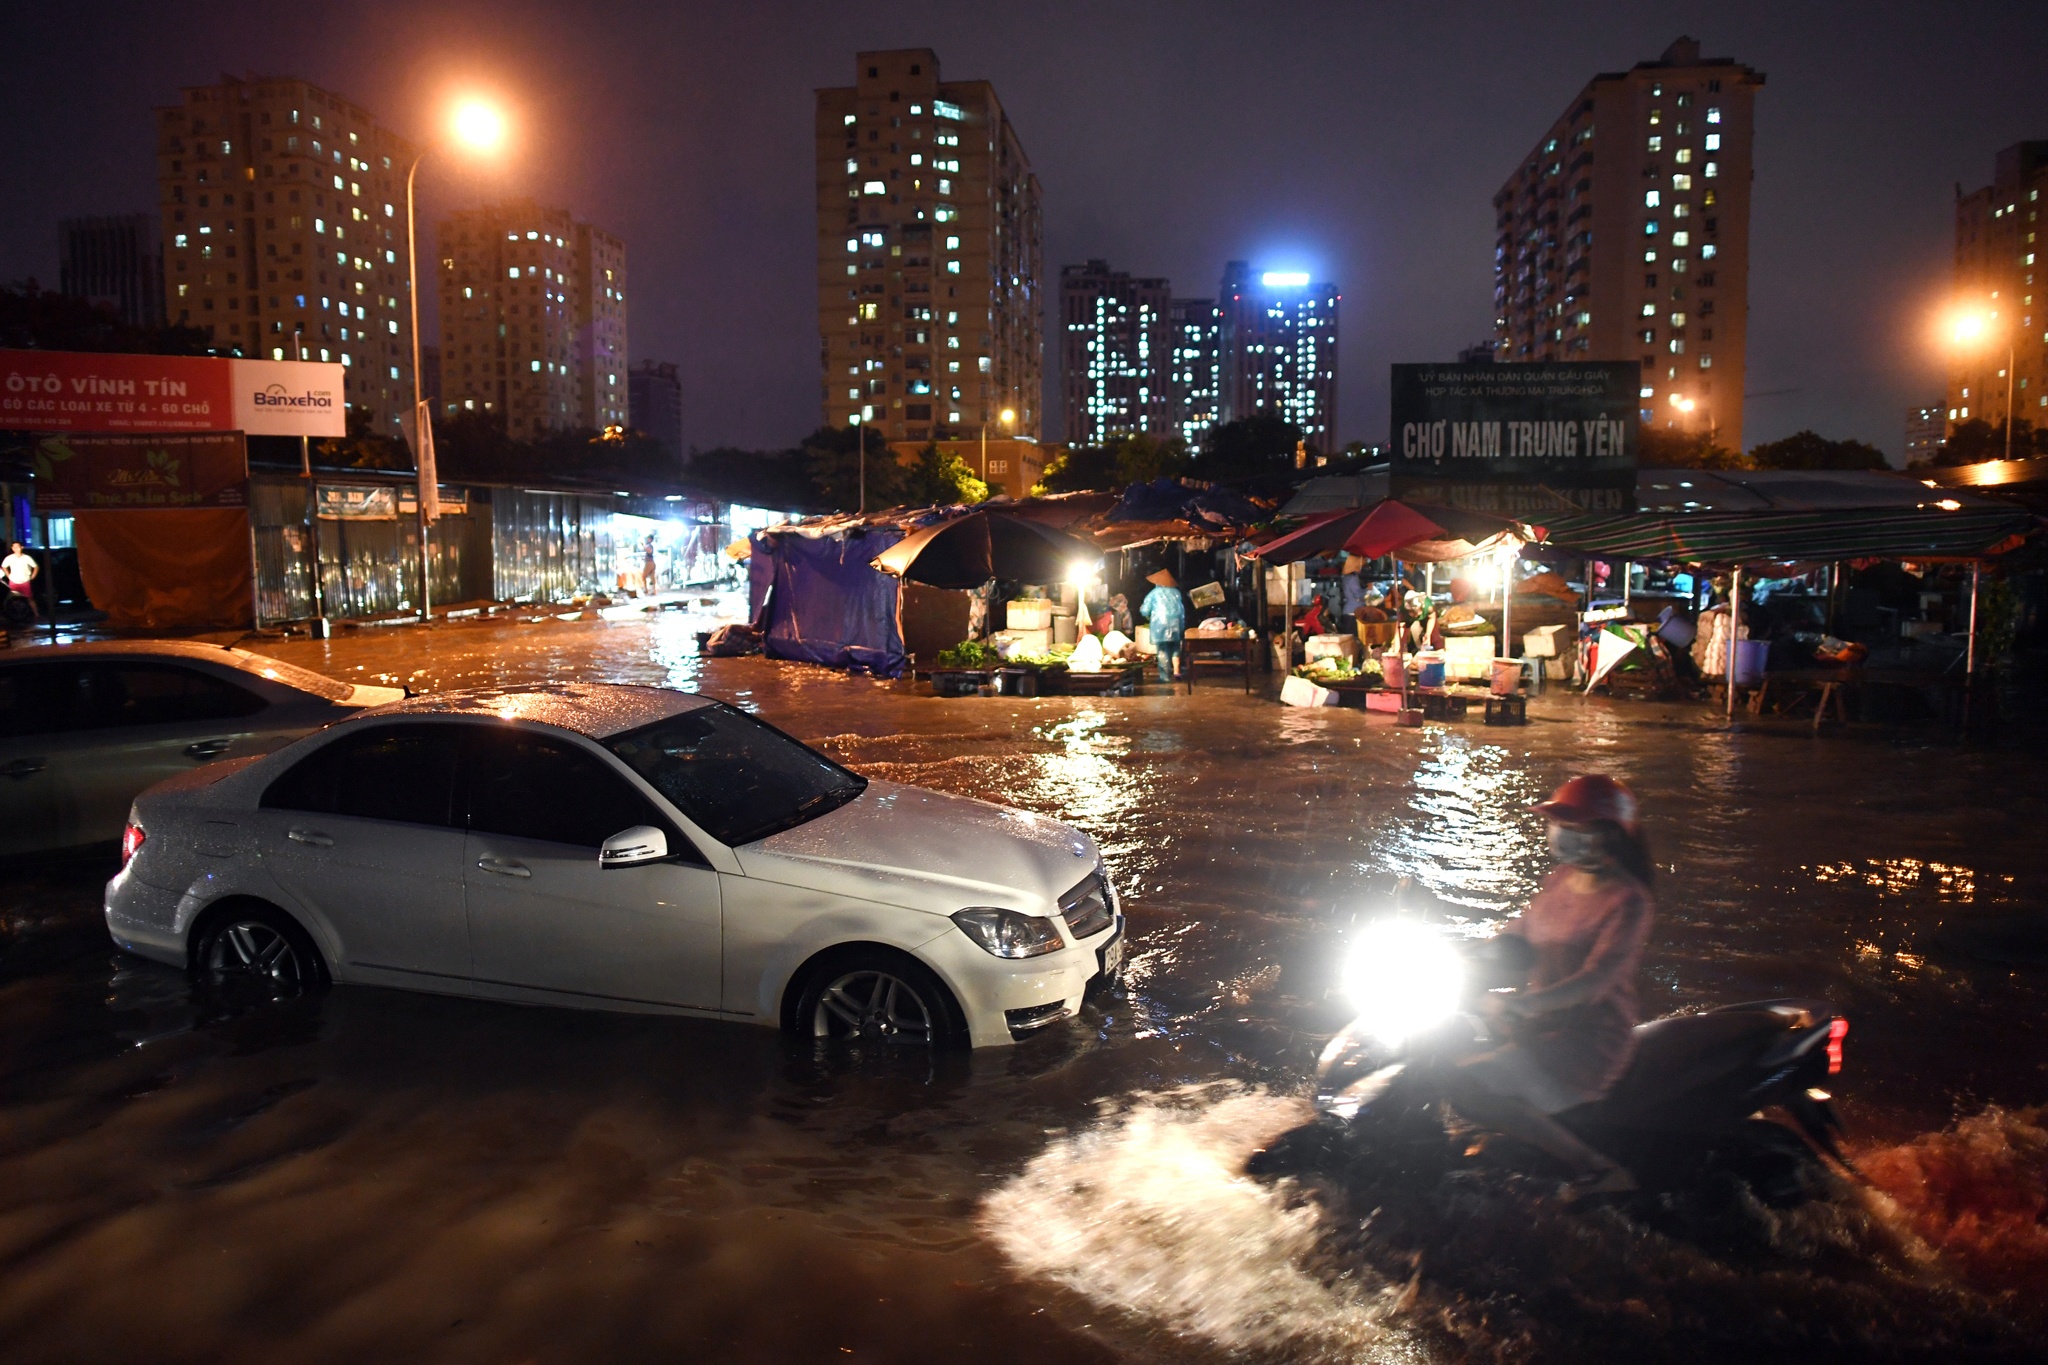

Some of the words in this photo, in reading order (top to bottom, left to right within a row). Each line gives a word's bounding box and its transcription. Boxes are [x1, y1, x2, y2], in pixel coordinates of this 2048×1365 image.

[6, 372, 62, 393] ÔTÔ
[71, 374, 135, 396] VĨNH
[143, 376, 187, 397] TÍN
[27, 396, 56, 411] CÁC
[60, 400, 92, 414] LOẠI
[96, 401, 113, 413] XE
[138, 402, 147, 413] 4
[254, 391, 331, 407] Banxehoi
[1402, 418, 1447, 466] CHỢ
[1452, 421, 1502, 458] NAM
[1507, 420, 1578, 458] TRUNG
[1583, 412, 1625, 457] YÊN
